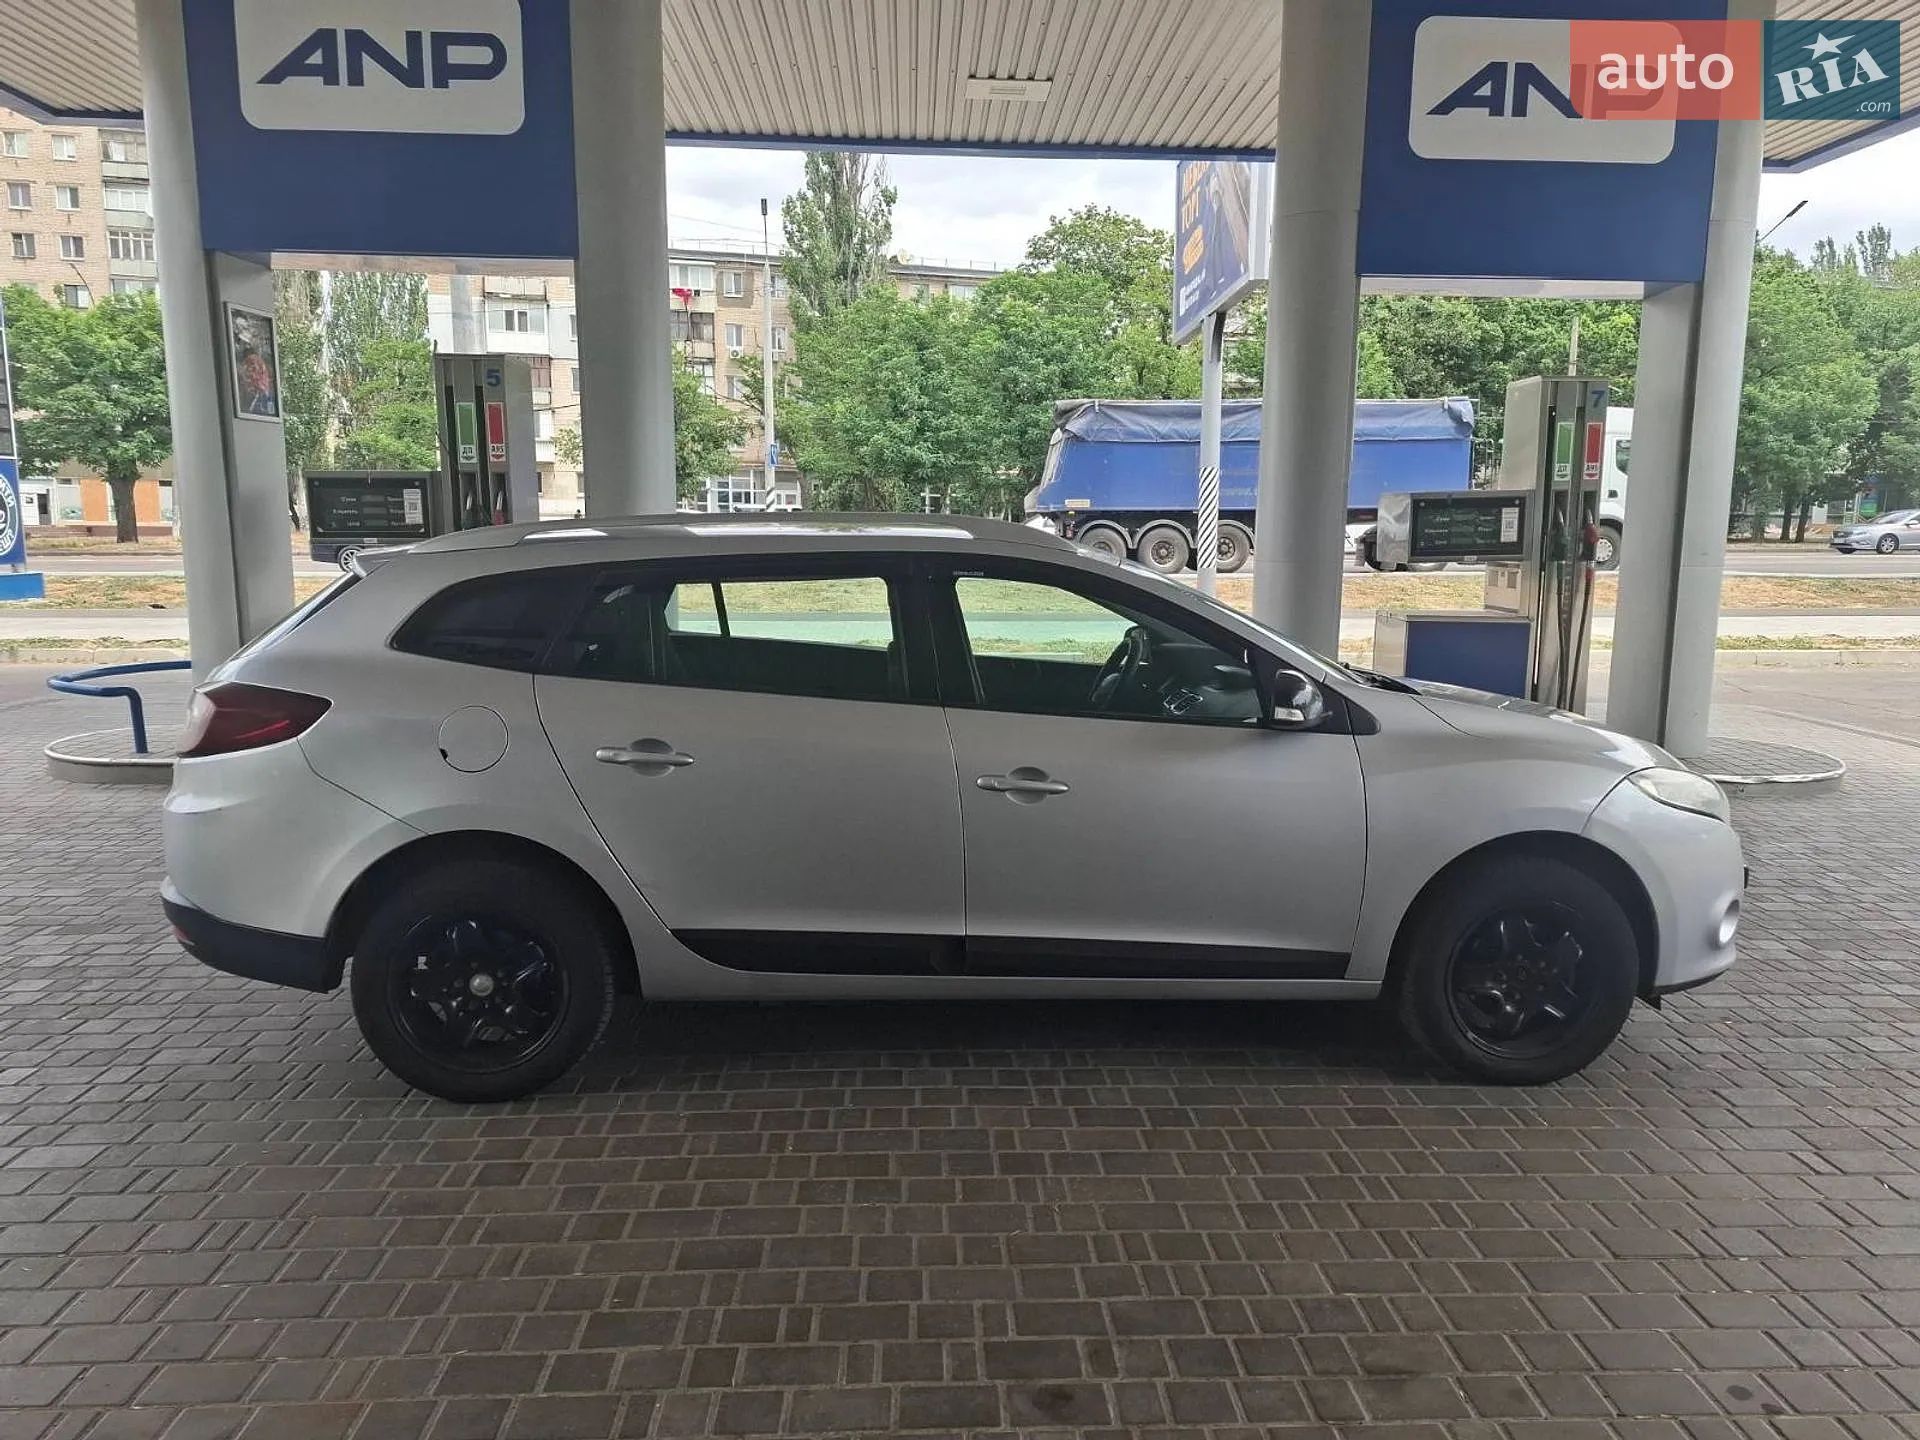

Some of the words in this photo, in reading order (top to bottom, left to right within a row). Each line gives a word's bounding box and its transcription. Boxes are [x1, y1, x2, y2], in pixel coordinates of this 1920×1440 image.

[256, 28, 508, 89] ANP
[486, 368, 501, 387] 5
[1591, 390, 1605, 408] 7
